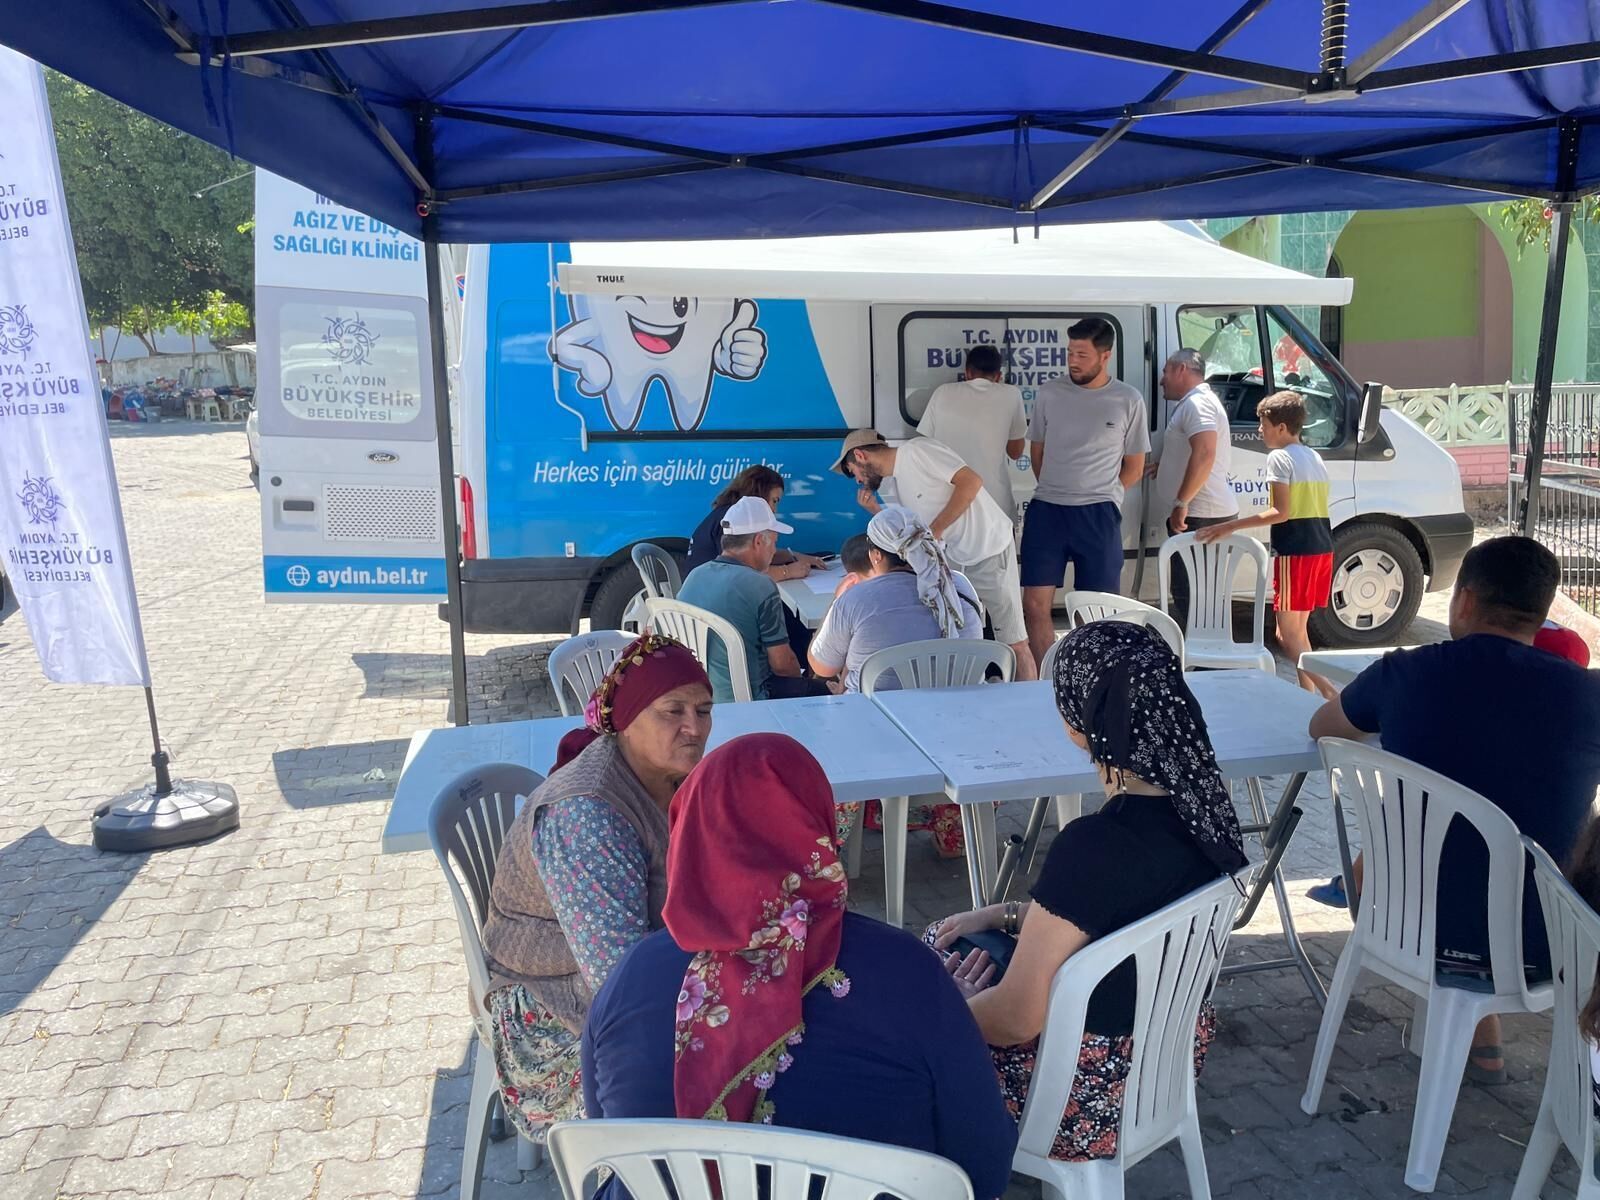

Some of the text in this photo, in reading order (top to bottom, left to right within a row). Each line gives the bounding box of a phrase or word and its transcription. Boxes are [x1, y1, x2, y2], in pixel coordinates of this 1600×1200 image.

[293, 210, 338, 230] AĞIZ
[341, 215, 366, 232] VE
[273, 234, 419, 262] SAĞLIĞI KLİNİĞİ
[596, 275, 625, 283] THULE
[962, 329, 1058, 344] T.C. AYDIN
[312, 373, 386, 387] T.C. AYDIN
[283, 385, 414, 409] BÜYÜKŞEHİR
[307, 407, 392, 421] BELEDİYESİ
[533, 460, 600, 483] Herkes
[603, 459, 638, 487] için
[641, 459, 706, 486] sağlıklı
[317, 566, 428, 588] aydın.bel.tr
